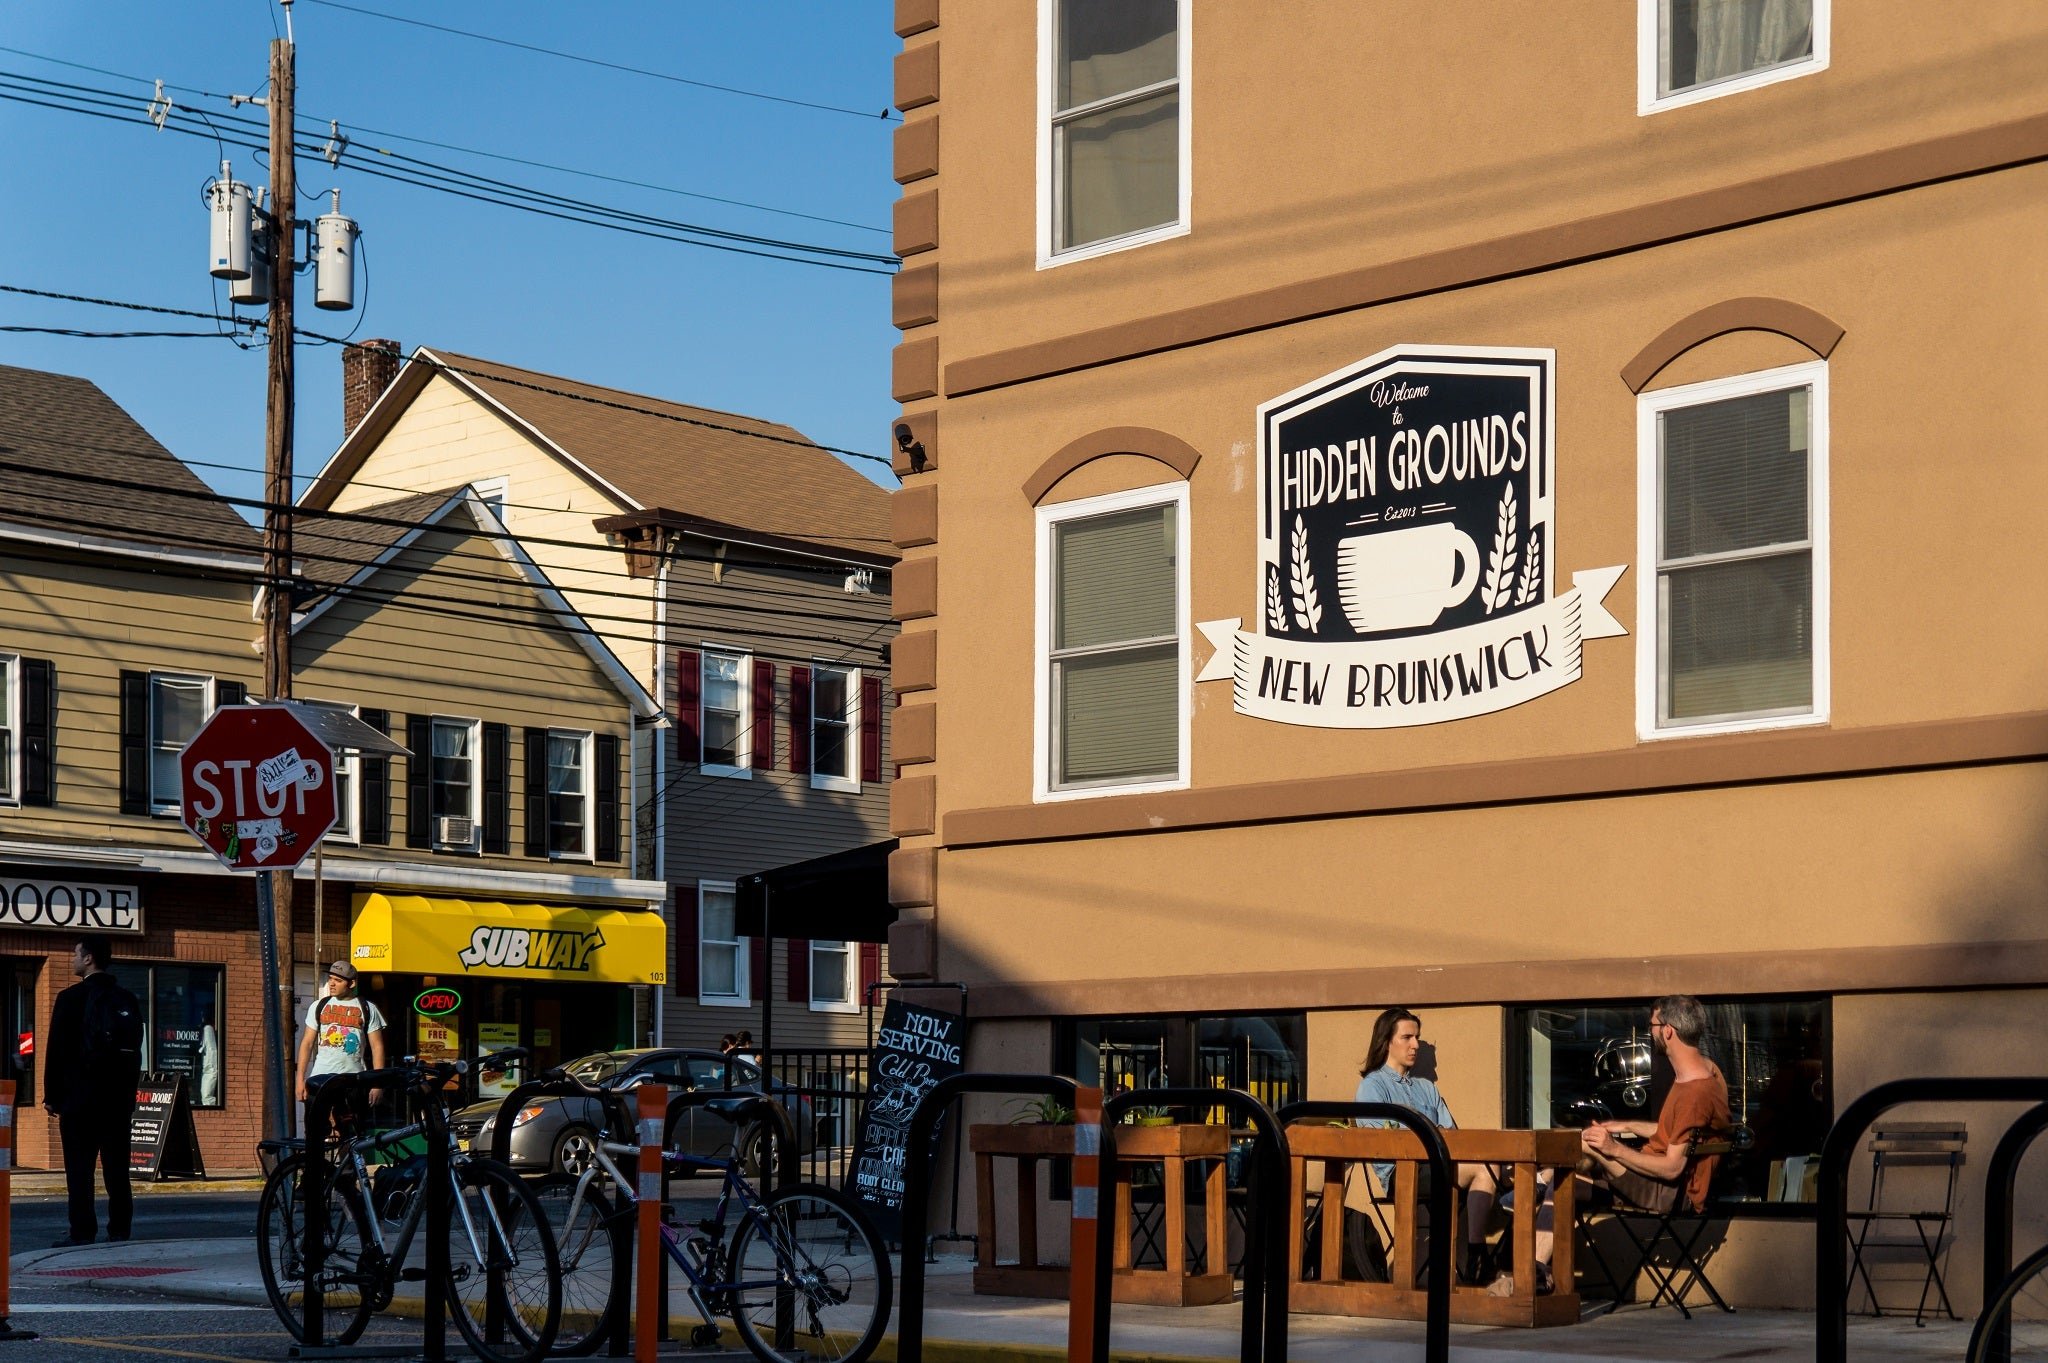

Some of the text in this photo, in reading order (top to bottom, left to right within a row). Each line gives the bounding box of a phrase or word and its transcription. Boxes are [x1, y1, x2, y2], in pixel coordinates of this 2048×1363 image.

[1370, 380, 1430, 408] Welcome
[1392, 405, 1404, 426] to
[1282, 411, 1528, 511] HIDDEN GROUNDS
[1258, 624, 1553, 708] NEW BRUNSWICK
[192, 758, 324, 819] STOP
[353, 943, 389, 959] SUBWAY
[457, 925, 606, 972] SUBWAY
[650, 972, 665, 982] 103
[420, 994, 455, 1009] OPEN
[428, 1030, 448, 1039] FREE
[903, 1011, 952, 1040] NOW
[877, 1028, 960, 1065] SERVING
[878, 1053, 915, 1079] Cold
[857, 1173, 905, 1193] BODY CLEA
